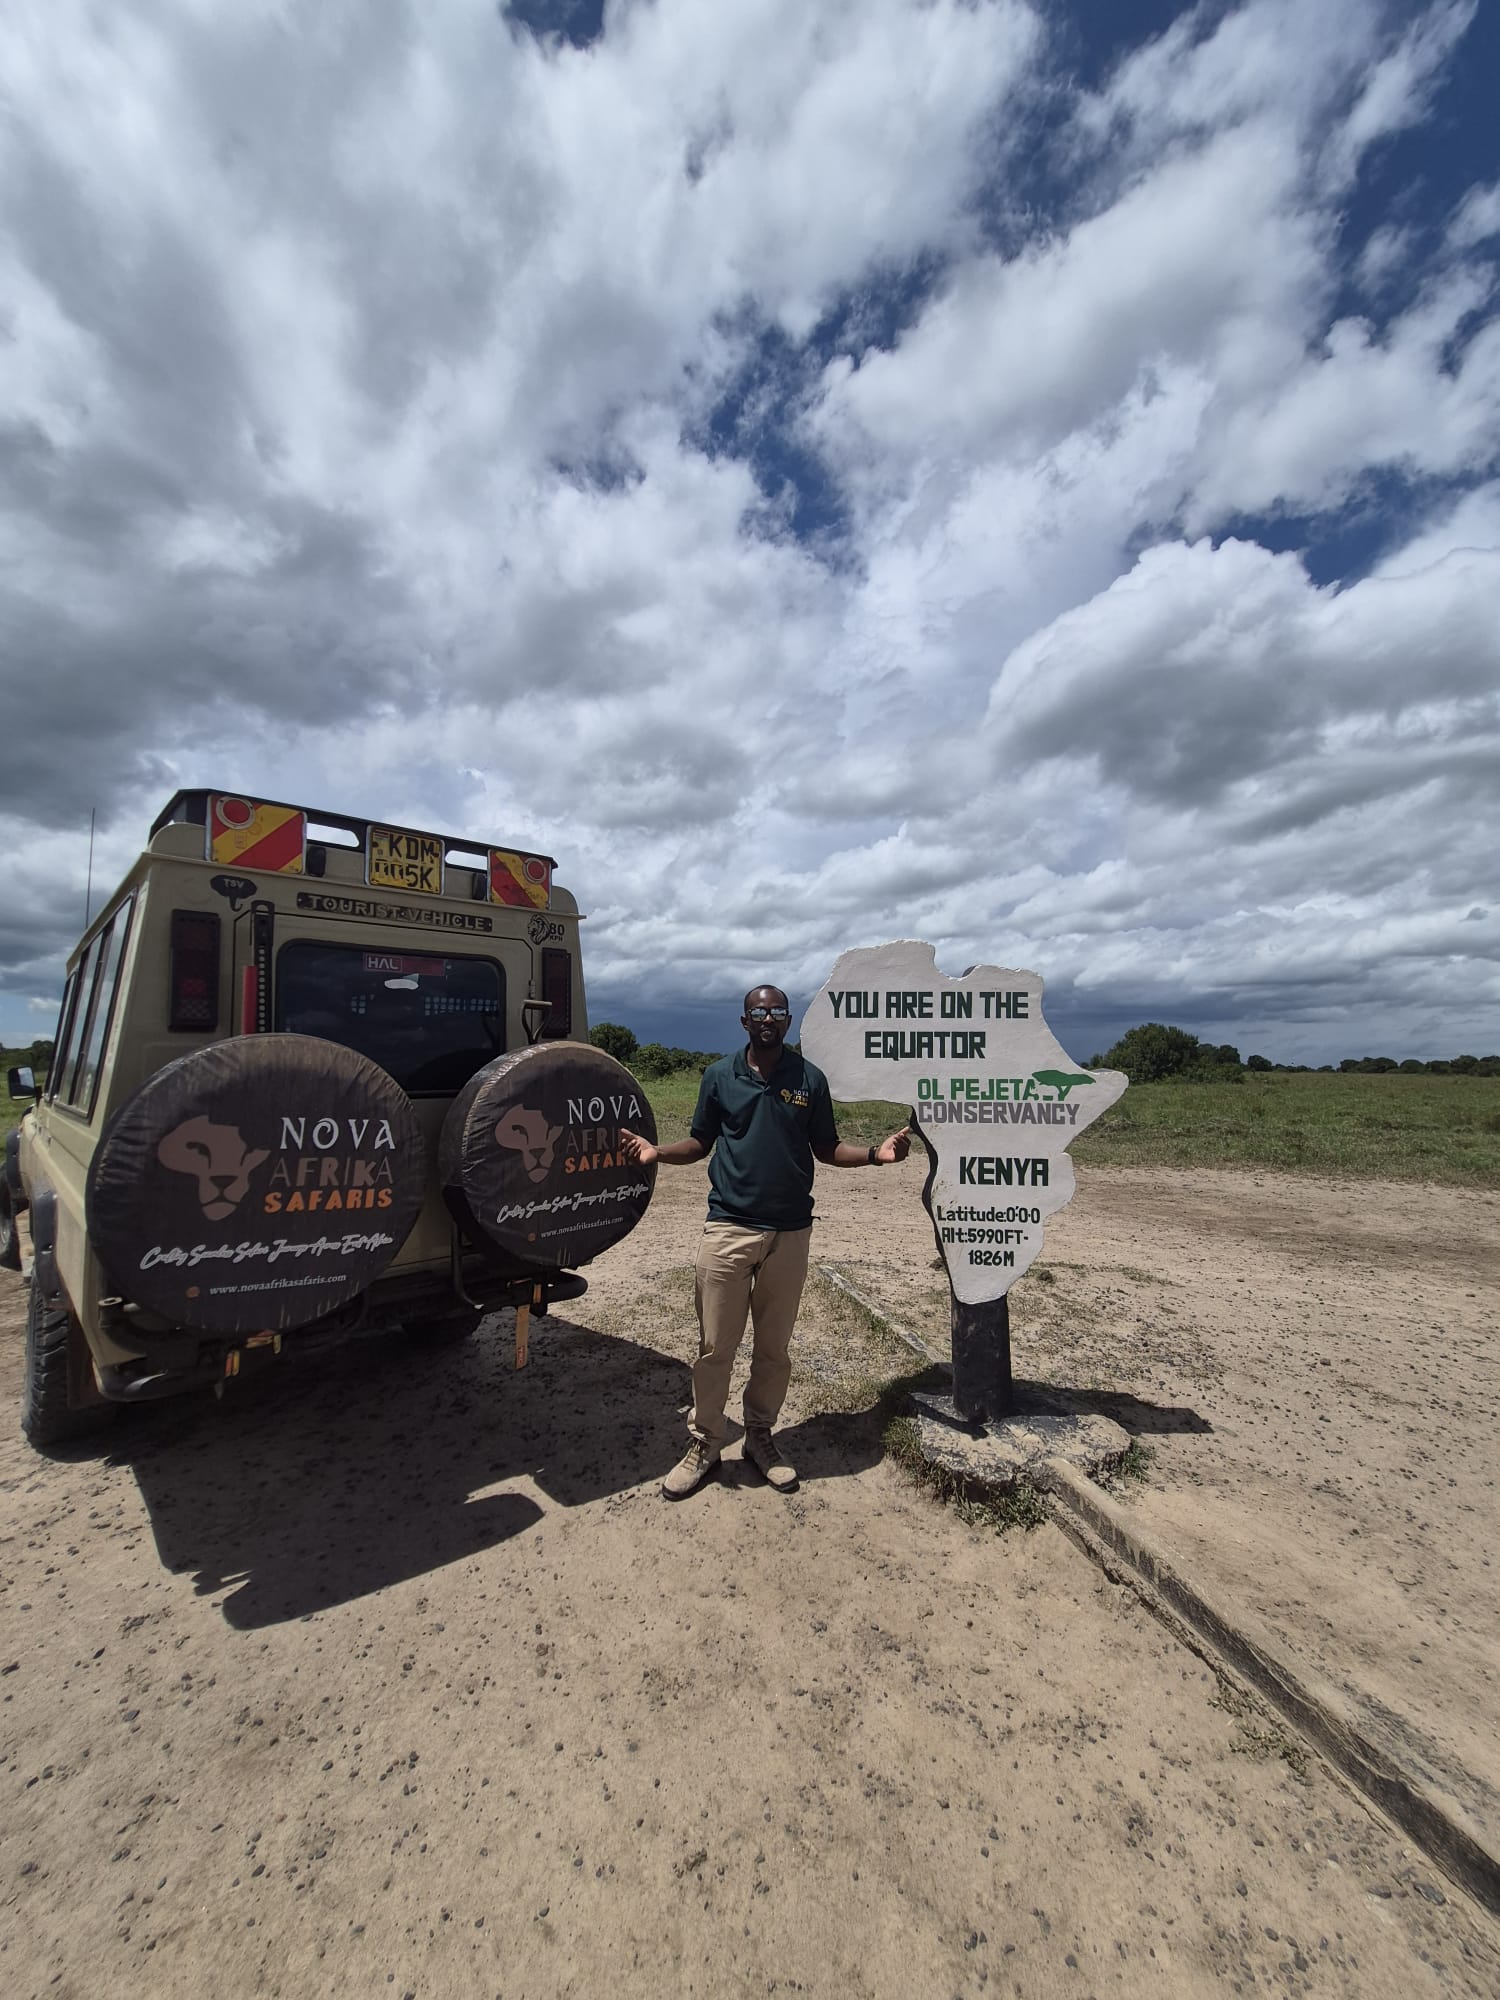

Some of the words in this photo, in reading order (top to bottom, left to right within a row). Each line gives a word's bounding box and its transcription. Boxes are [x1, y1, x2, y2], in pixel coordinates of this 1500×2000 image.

[389, 833, 435, 864] KDM
[223, 878, 245, 889] TSV
[307, 894, 400, 919] TOURIST
[407, 908, 486, 930] VEHICLE
[550, 922, 565, 936] 80
[828, 991, 879, 1019] YOU
[885, 991, 934, 1019] ARE
[941, 991, 973, 1019] ON
[979, 991, 1029, 1019] THE
[865, 1031, 986, 1061] EQUATOR
[917, 1078, 945, 1100] OL
[950, 1078, 1040, 1101] PEJETA
[567, 1094, 642, 1124] NOVA
[918, 1101, 1080, 1125] CONSERVANCY
[279, 1116, 396, 1150] NOVA
[566, 1124, 642, 1153] AFRI
[268, 1156, 393, 1187] AFRIKA
[564, 1151, 627, 1174] SAFAR
[959, 1156, 1049, 1187] KENYA
[264, 1188, 393, 1214] SAFARIS
[209, 1274, 347, 1295] www.novaafrikasafaris.com
